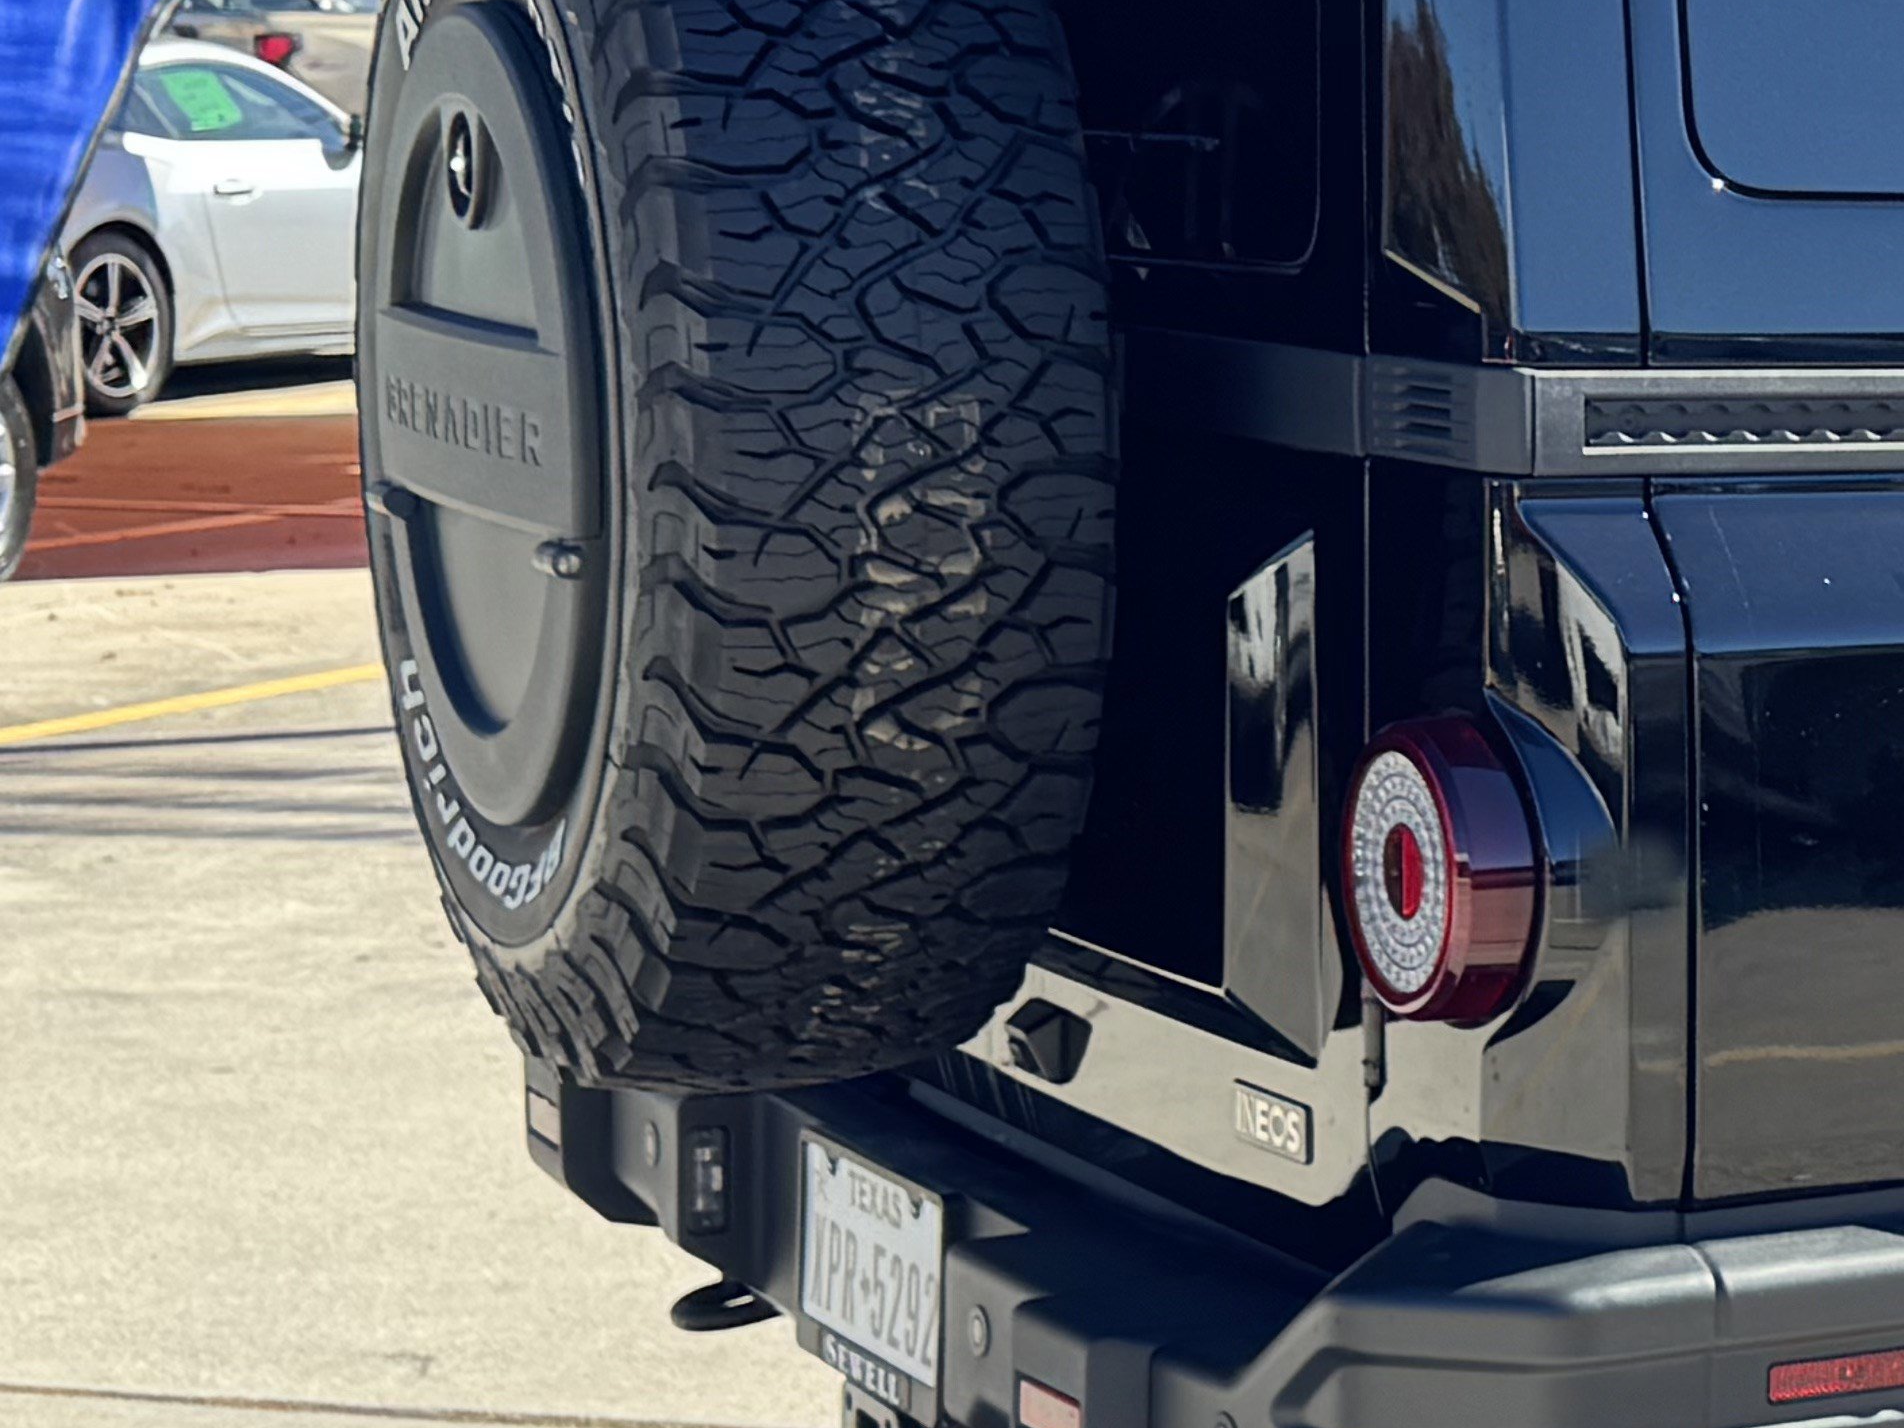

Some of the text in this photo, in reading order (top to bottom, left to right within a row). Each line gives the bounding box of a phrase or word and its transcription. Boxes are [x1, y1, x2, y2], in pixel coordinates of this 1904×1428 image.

[385, 373, 543, 468] GRENADIER
[400, 658, 567, 911] BFGoodrich
[1236, 1089, 1301, 1153] INEOS
[846, 1170, 902, 1230] TEXAS
[821, 1332, 900, 1407] SEWELL
